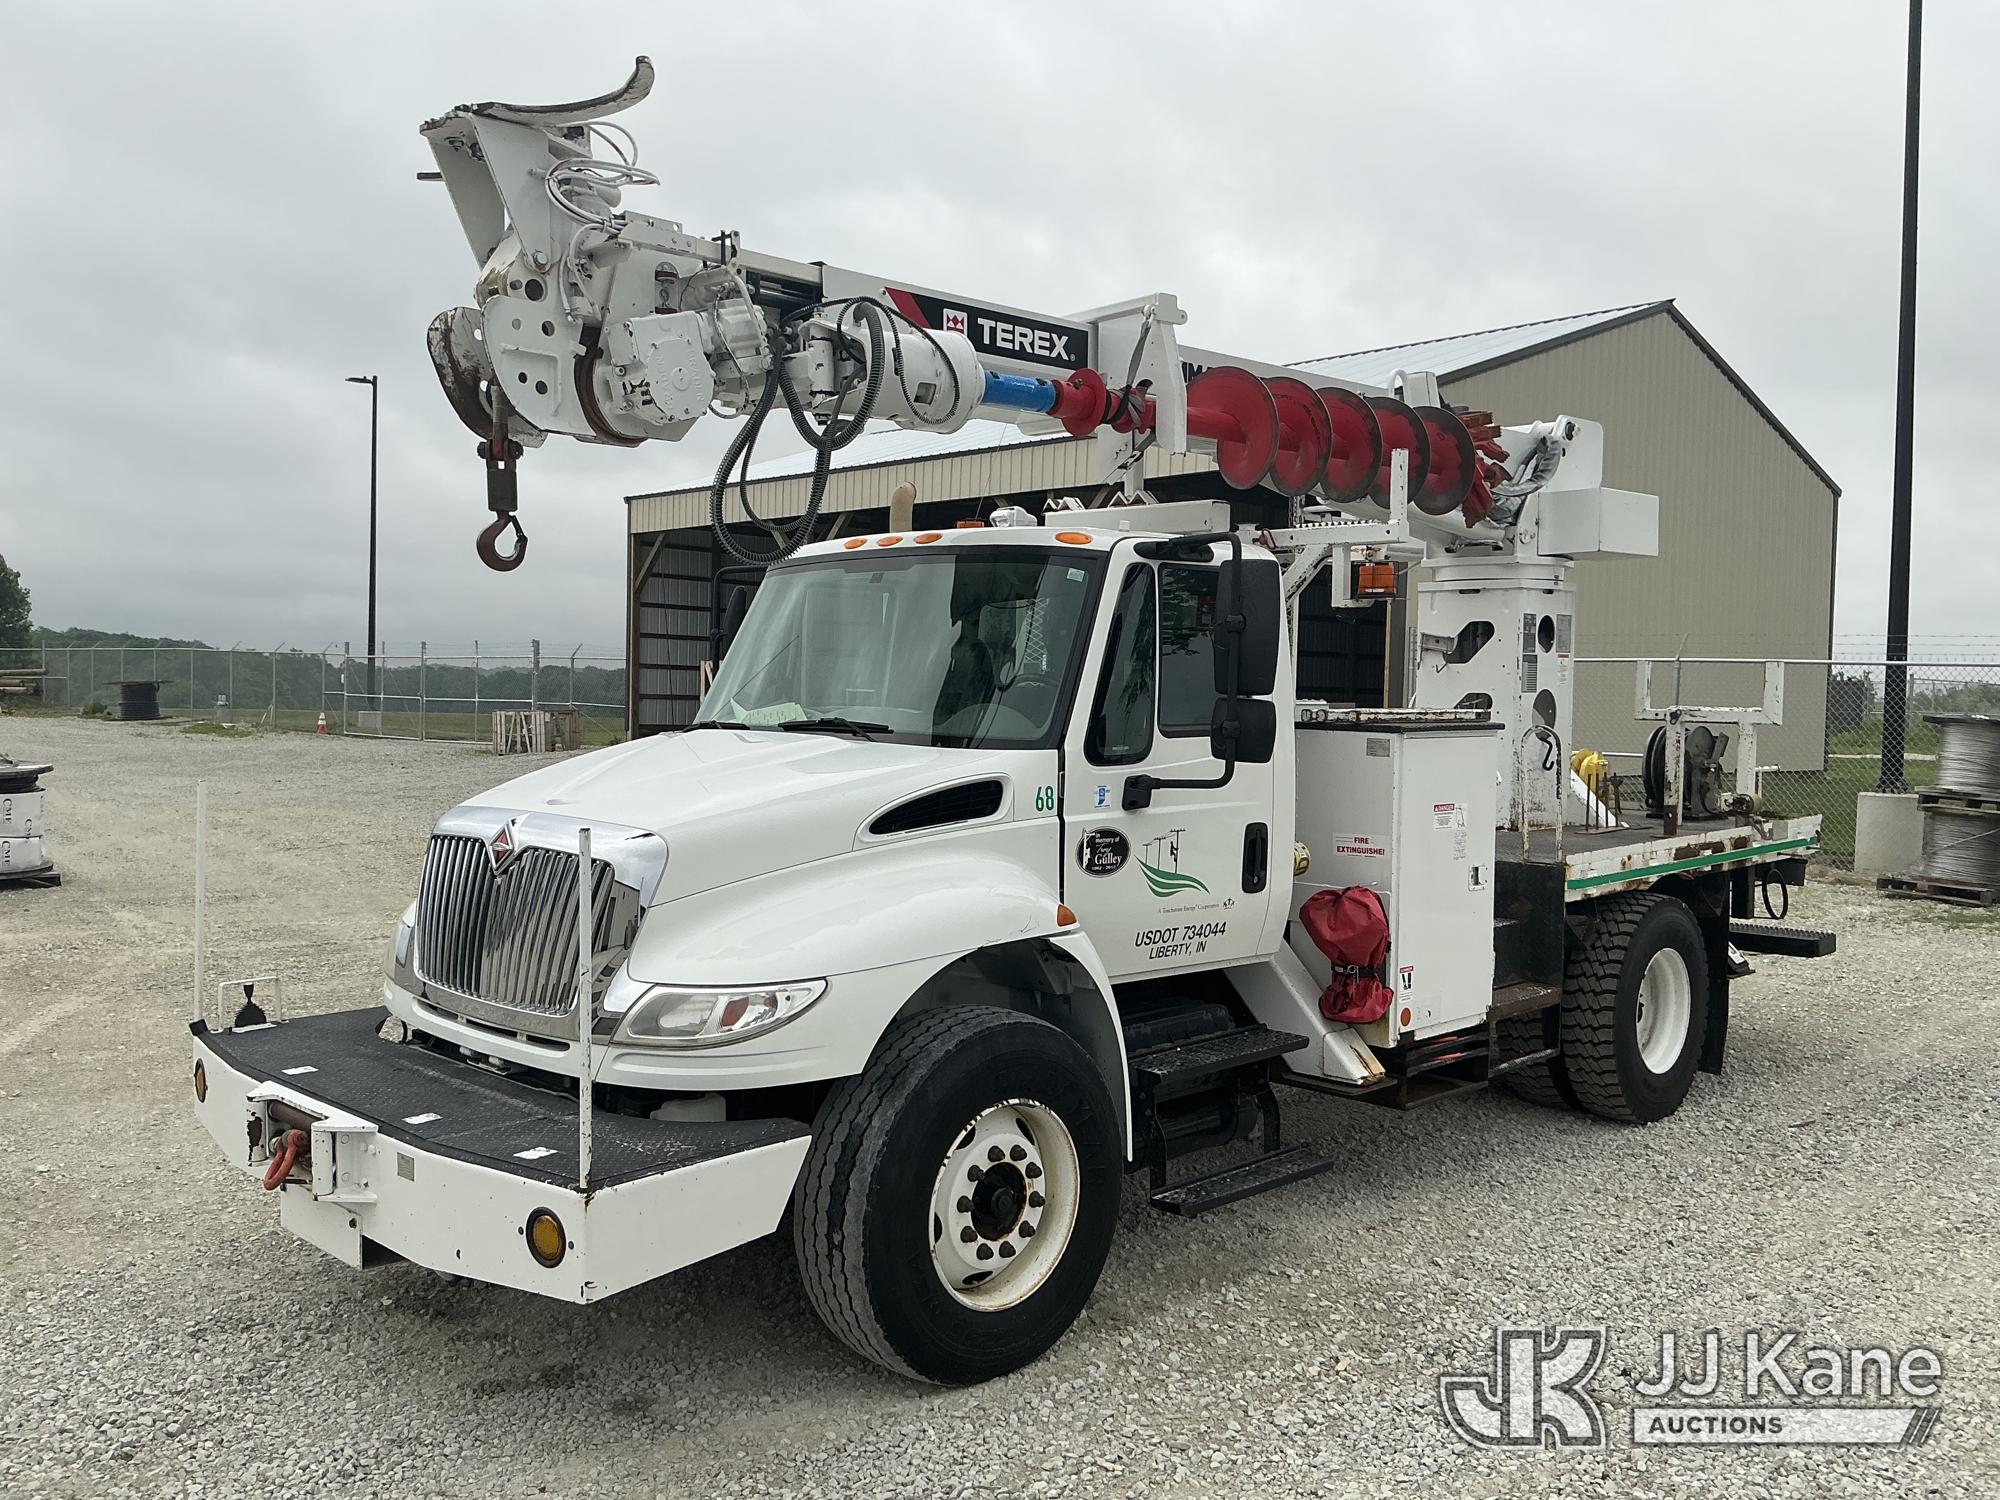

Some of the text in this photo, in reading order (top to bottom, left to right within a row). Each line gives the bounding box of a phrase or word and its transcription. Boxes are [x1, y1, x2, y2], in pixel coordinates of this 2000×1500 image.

[1035, 785, 1054, 812] 68
[1354, 836, 1370, 844] FIRE
[1095, 852, 1122, 867] Gulley
[1135, 921, 1227, 947] USDOT 734044
[1149, 940, 1208, 960] LIBERTY, IN
